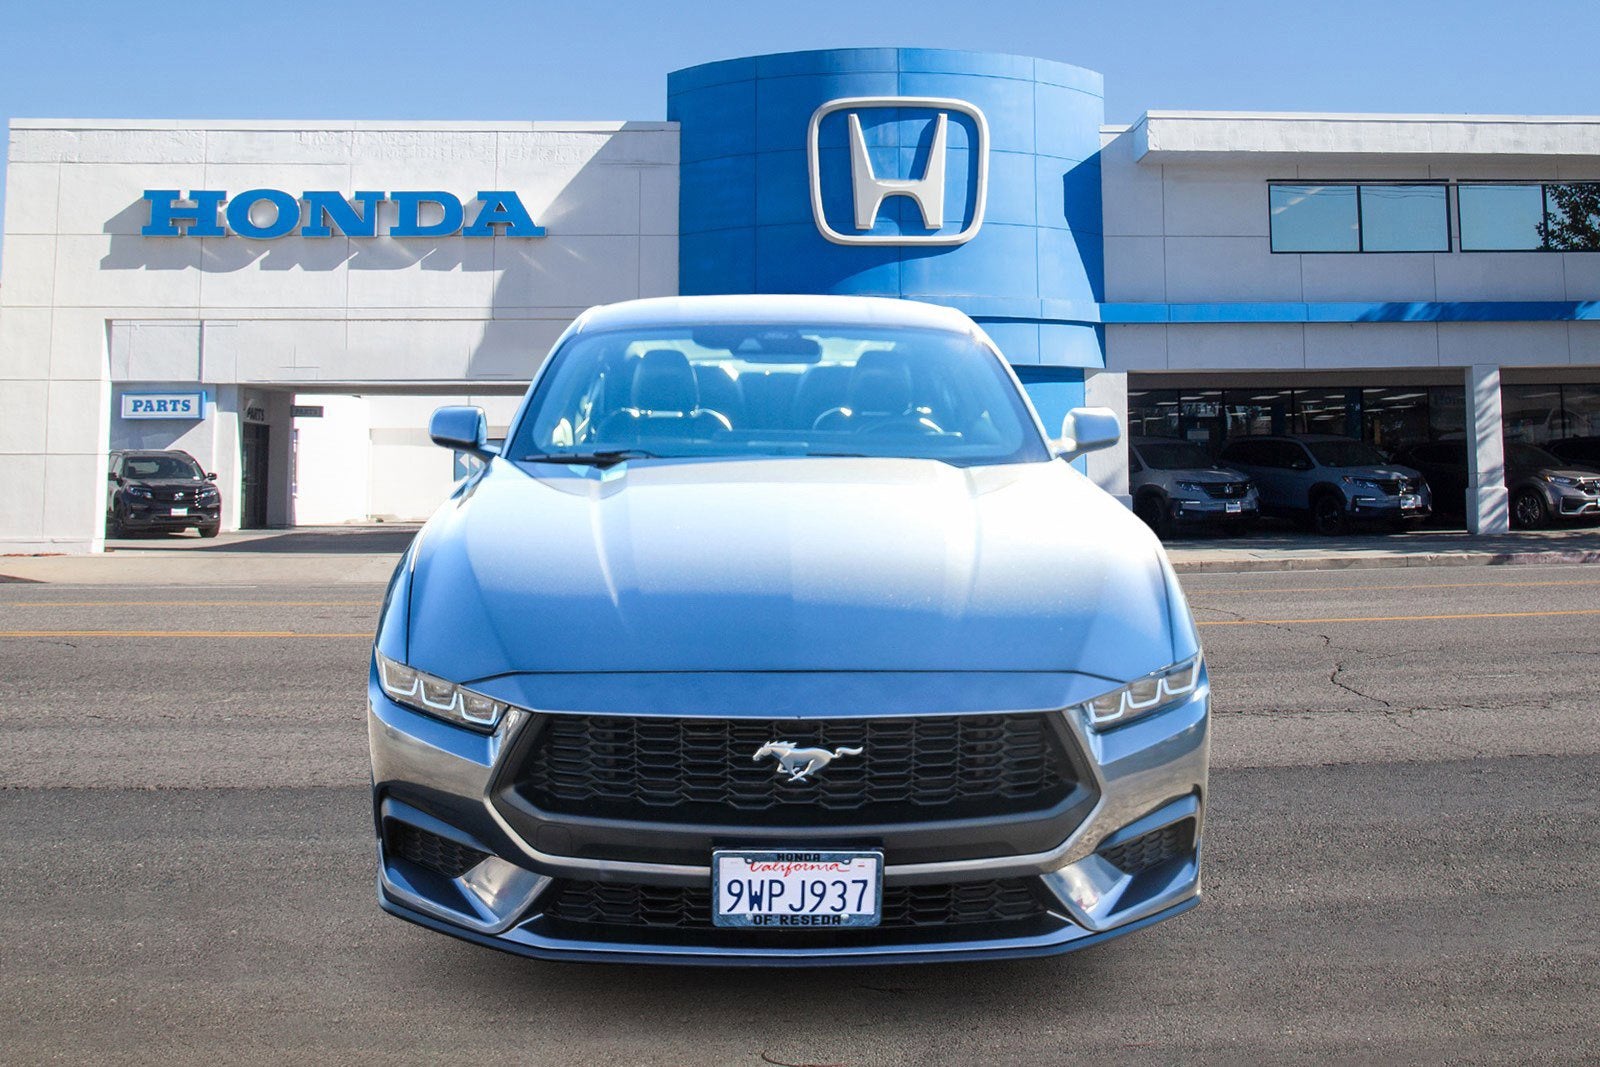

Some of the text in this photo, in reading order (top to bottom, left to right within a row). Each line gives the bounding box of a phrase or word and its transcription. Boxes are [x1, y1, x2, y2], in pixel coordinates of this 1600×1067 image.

[141, 188, 548, 239] HONDA
[131, 399, 191, 412] PARTS
[777, 853, 821, 862] HONDA
[750, 861, 850, 878] California
[726, 879, 869, 912] 9WPJ937
[753, 914, 842, 925] OF RESEDA
